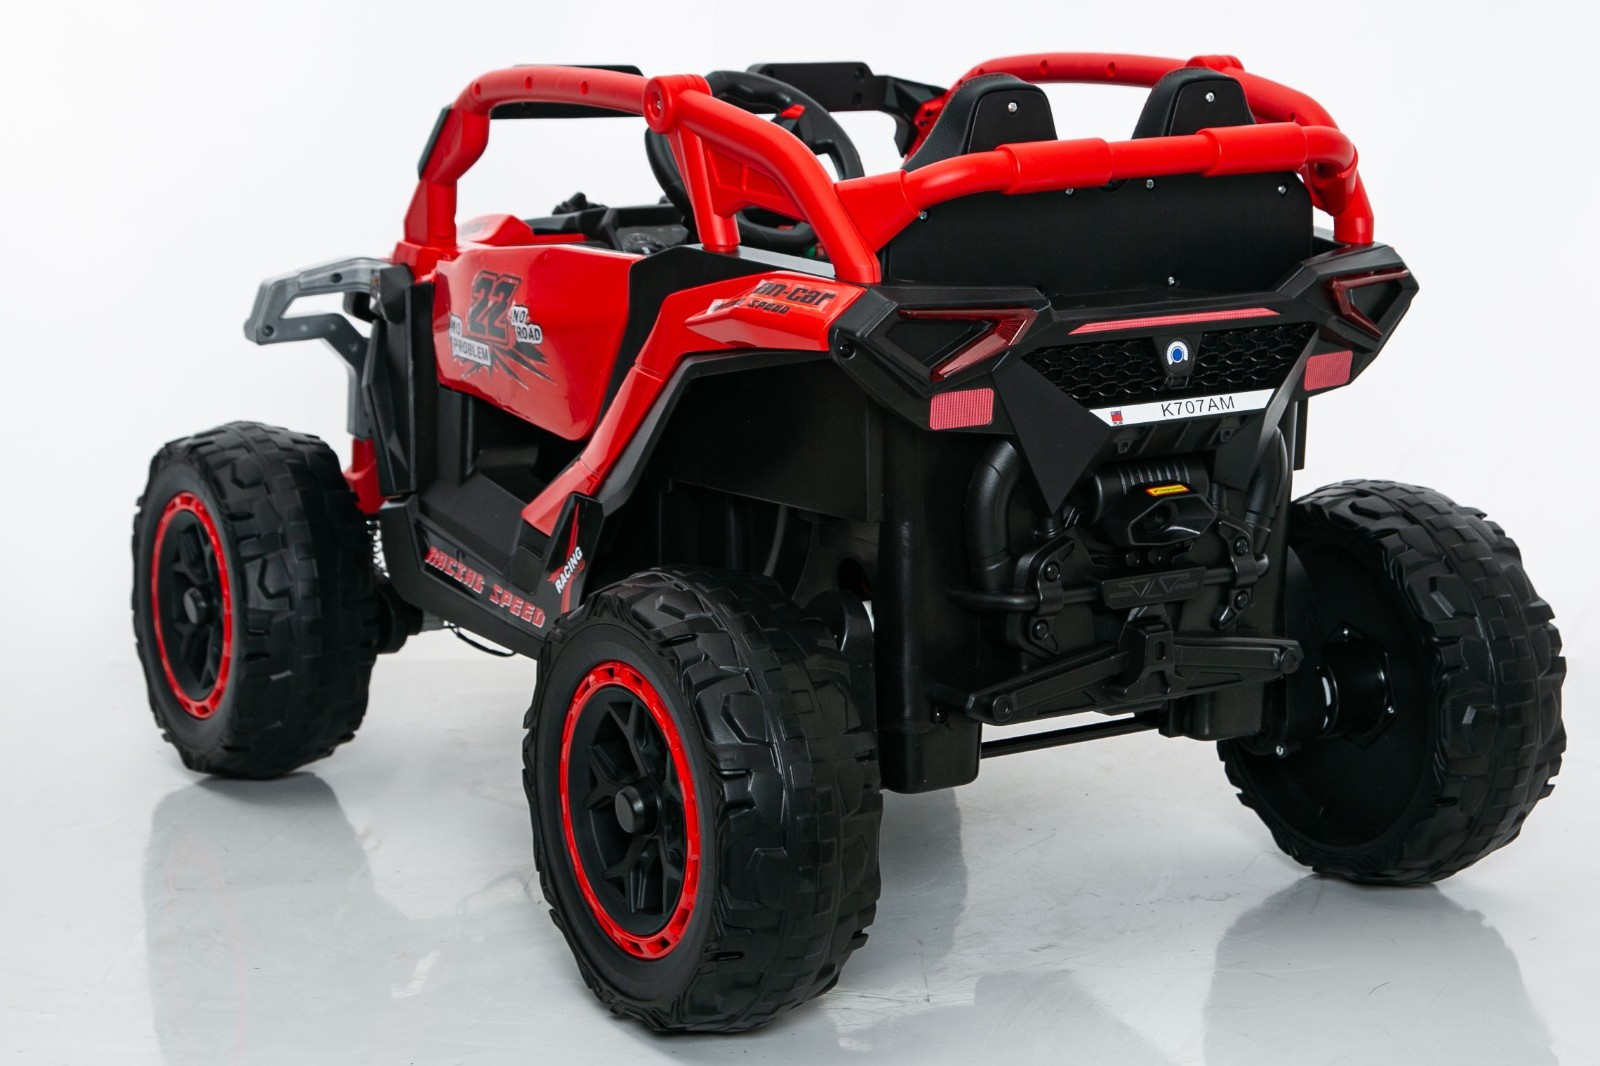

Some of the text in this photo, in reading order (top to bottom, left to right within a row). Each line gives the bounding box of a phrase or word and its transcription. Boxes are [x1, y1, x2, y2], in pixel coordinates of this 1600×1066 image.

[469, 271, 521, 345] 22
[512, 309, 526, 324] NO
[748, 299, 790, 315] SPEED
[517, 326, 542, 341] ROAD
[453, 338, 489, 360] PROBLEM
[1161, 396, 1235, 417] K707AM
[554, 546, 583, 594] RACING
[424, 546, 546, 629] RACING SPEED
